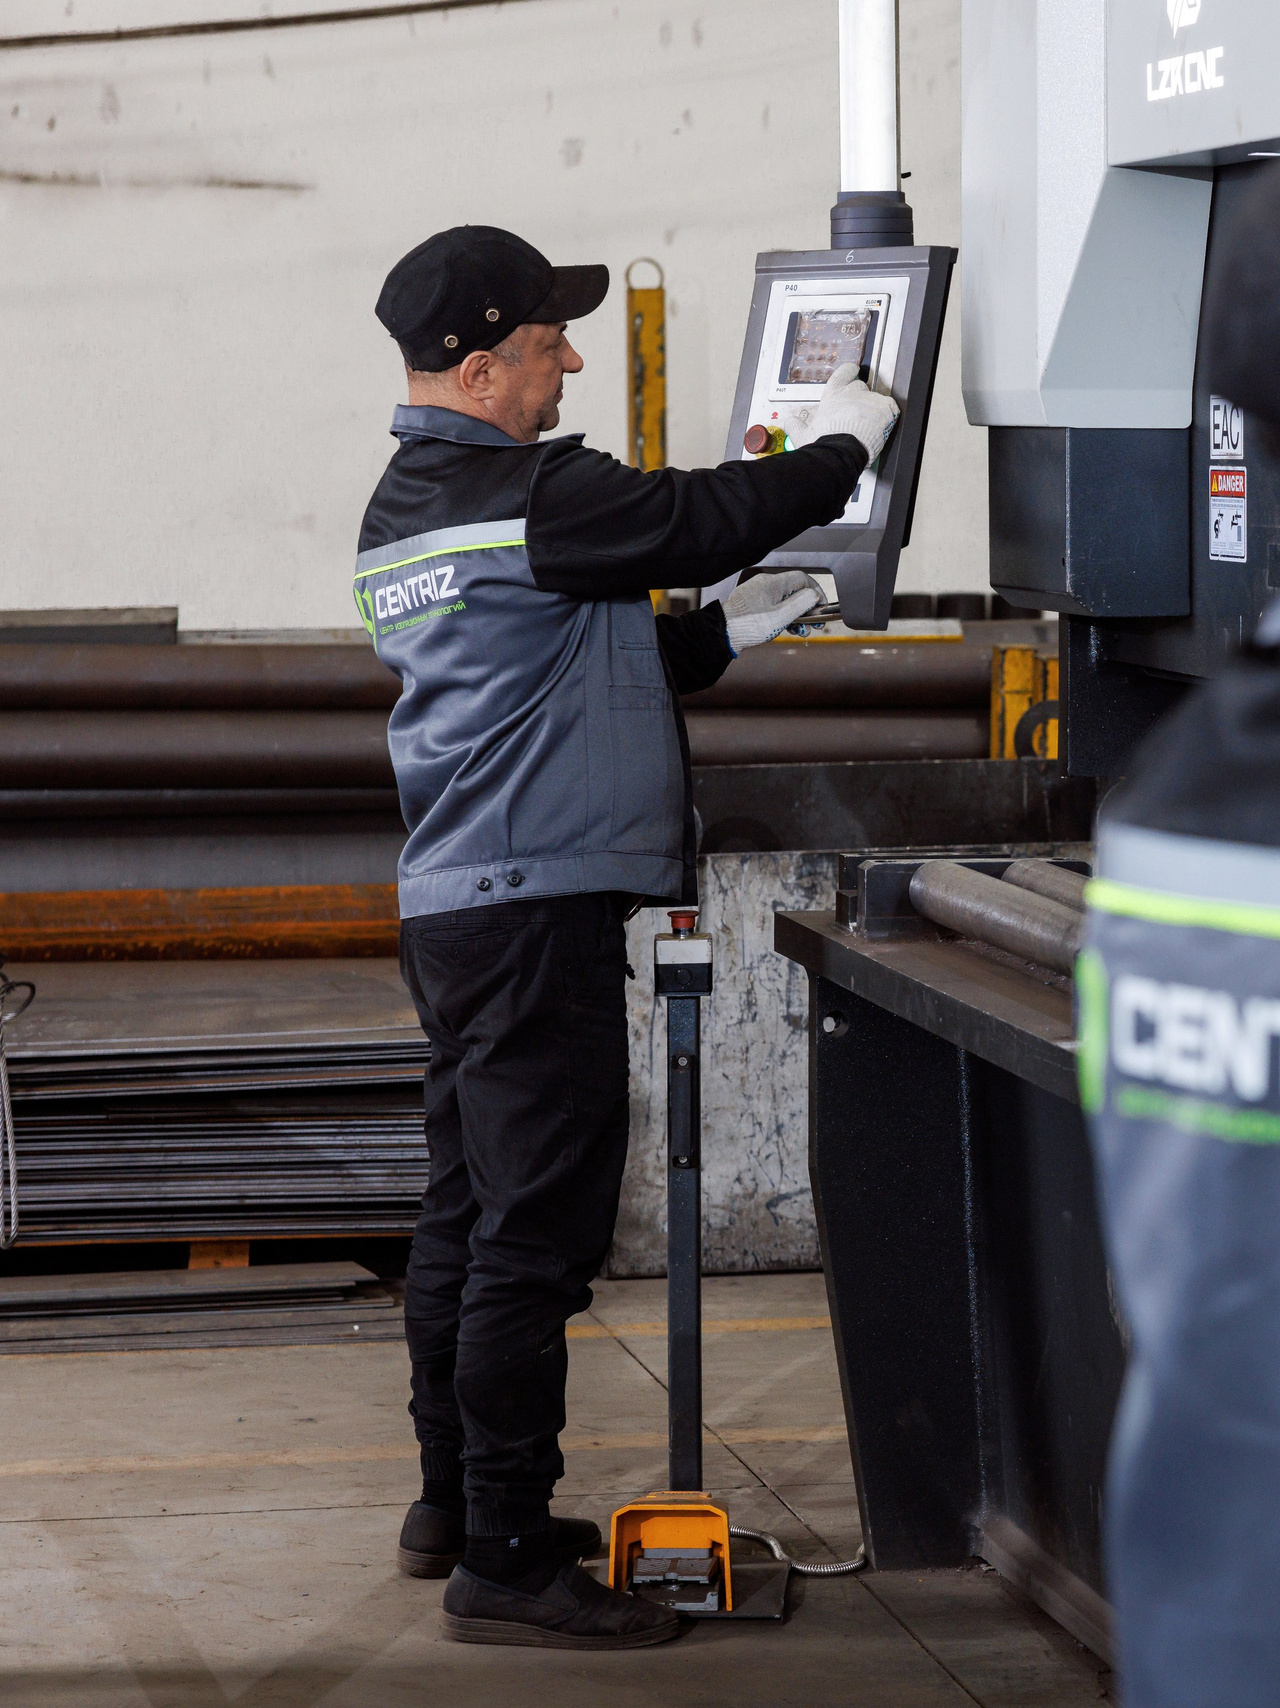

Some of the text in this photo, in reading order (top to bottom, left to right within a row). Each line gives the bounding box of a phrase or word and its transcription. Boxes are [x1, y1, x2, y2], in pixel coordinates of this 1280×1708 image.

[845, 249, 855, 263] 6
[784, 284, 798, 292] P40
[1212, 403, 1240, 451] EAC
[1218, 474, 1245, 492] DANGER
[374, 564, 460, 620] CENTRIZ
[379, 624, 394, 636] ЦЕНТР
